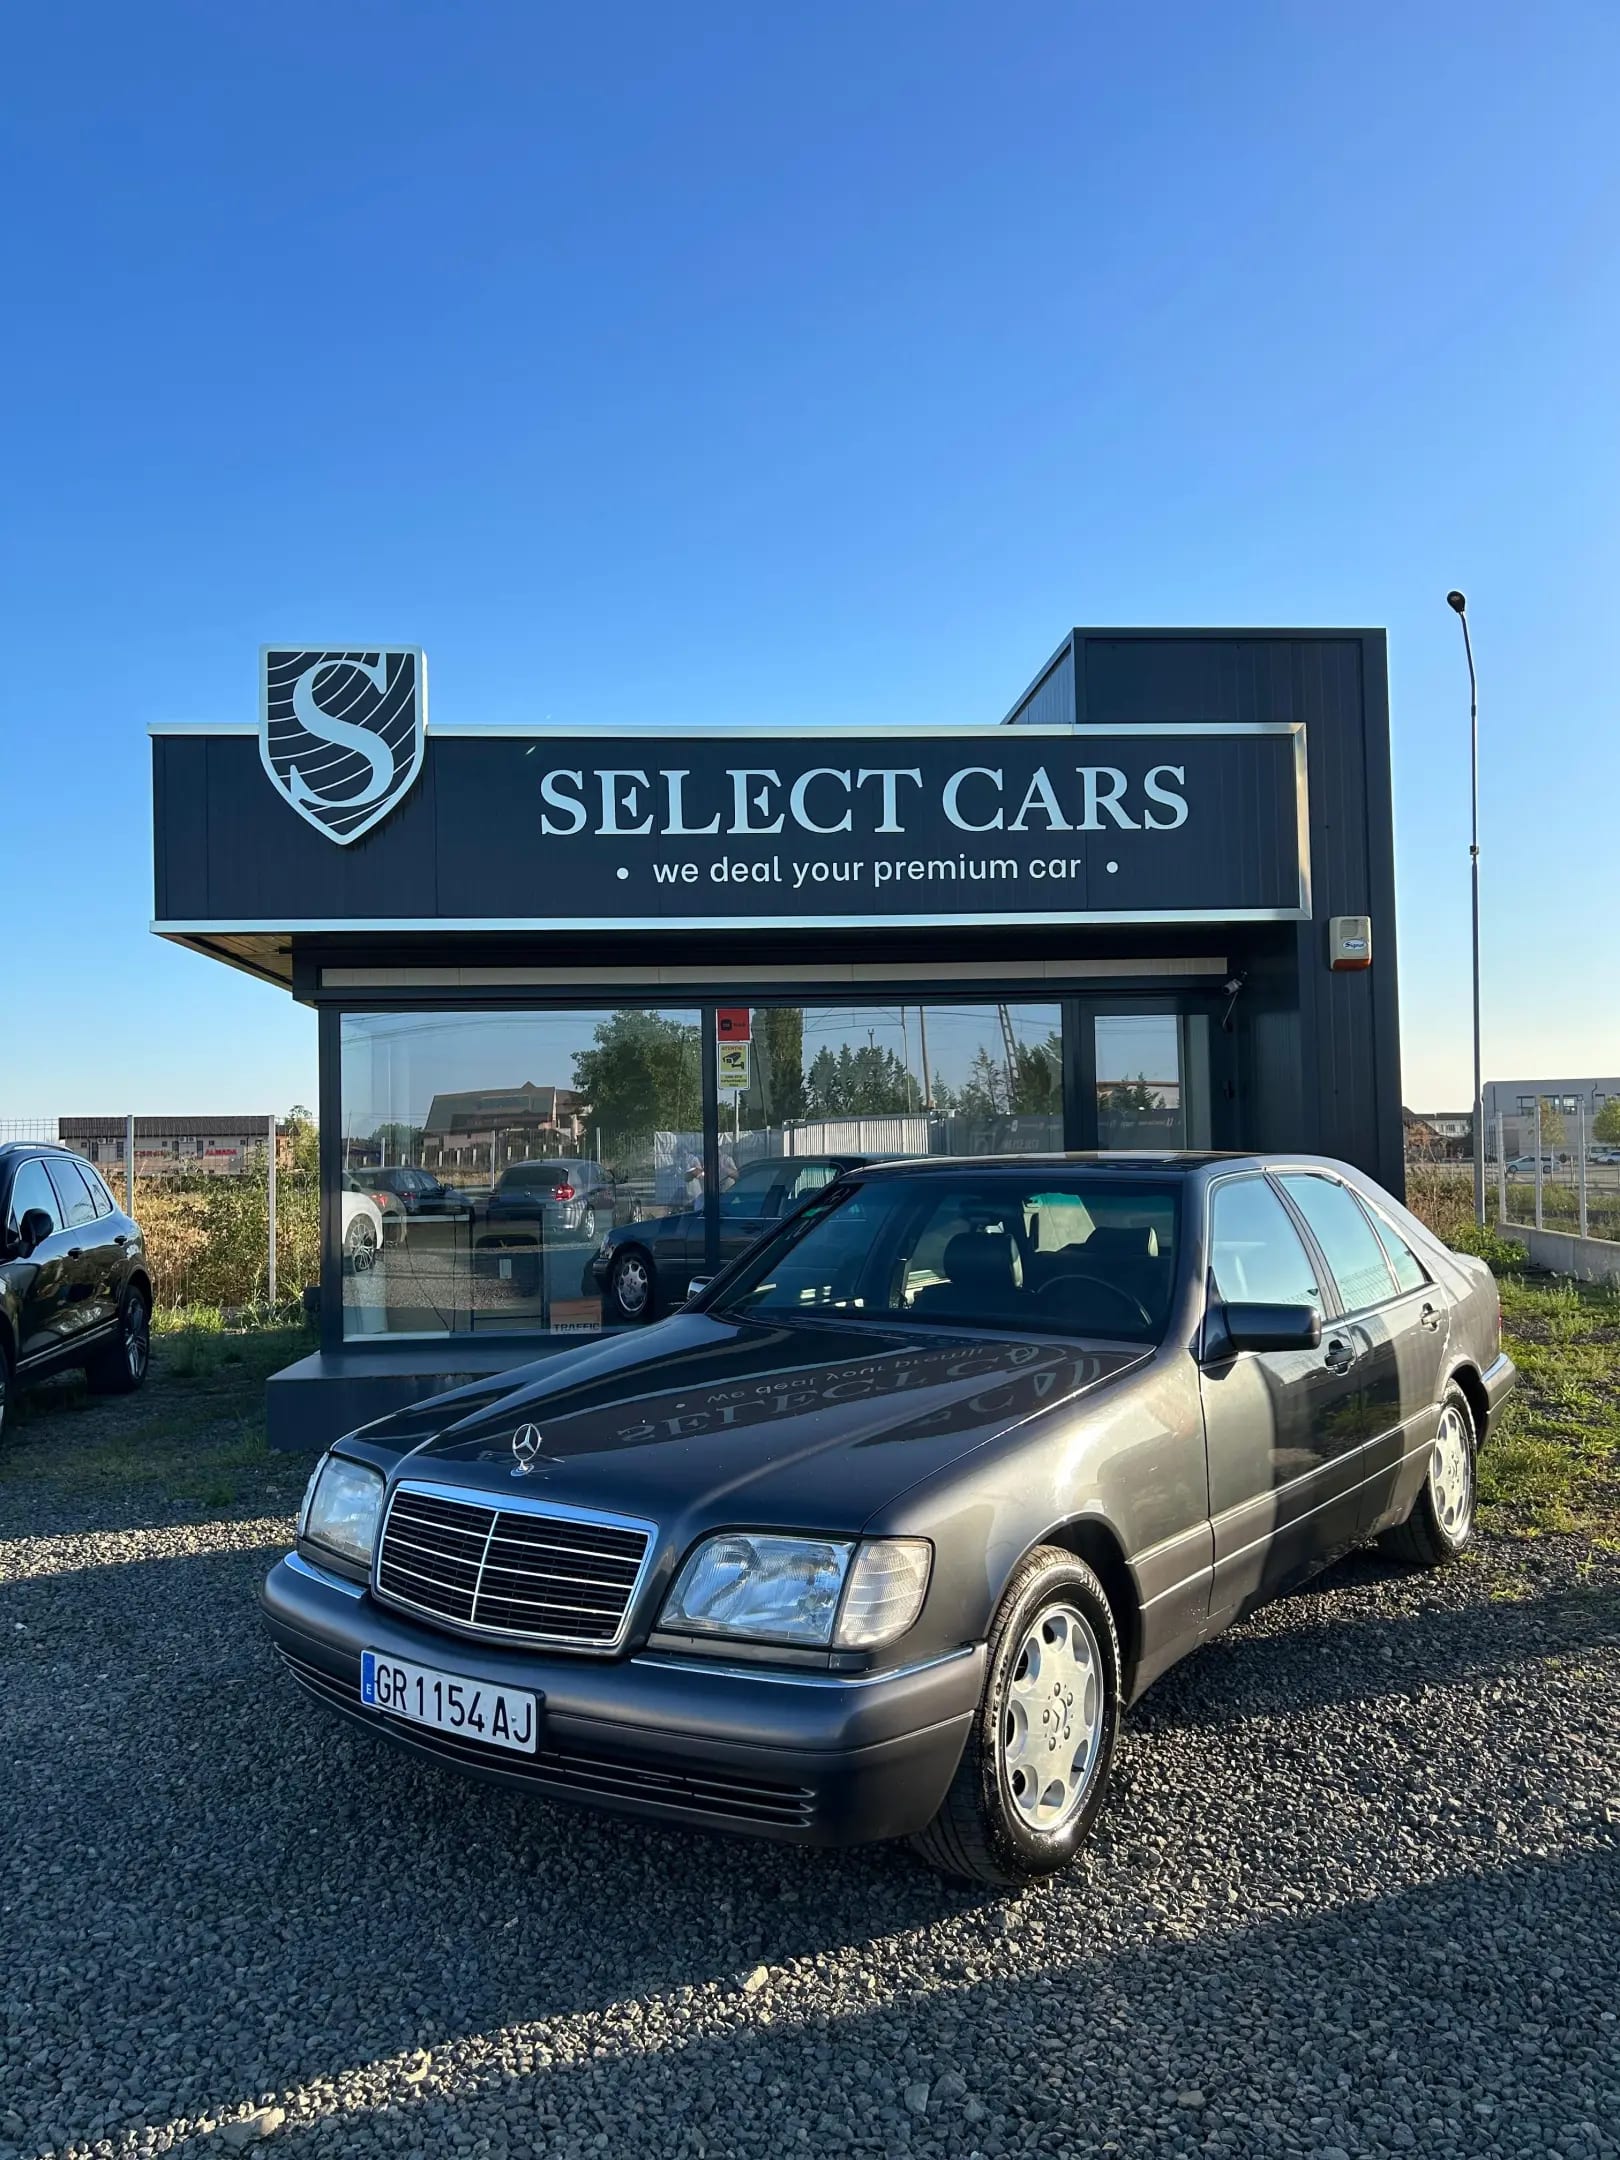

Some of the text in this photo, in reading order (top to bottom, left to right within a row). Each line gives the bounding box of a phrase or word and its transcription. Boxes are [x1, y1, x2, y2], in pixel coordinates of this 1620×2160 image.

[289, 651, 394, 808] S
[540, 765, 1189, 836] SELECT CARS
[652, 853, 1081, 889] we deal your premium car
[366, 1684, 372, 1695] E
